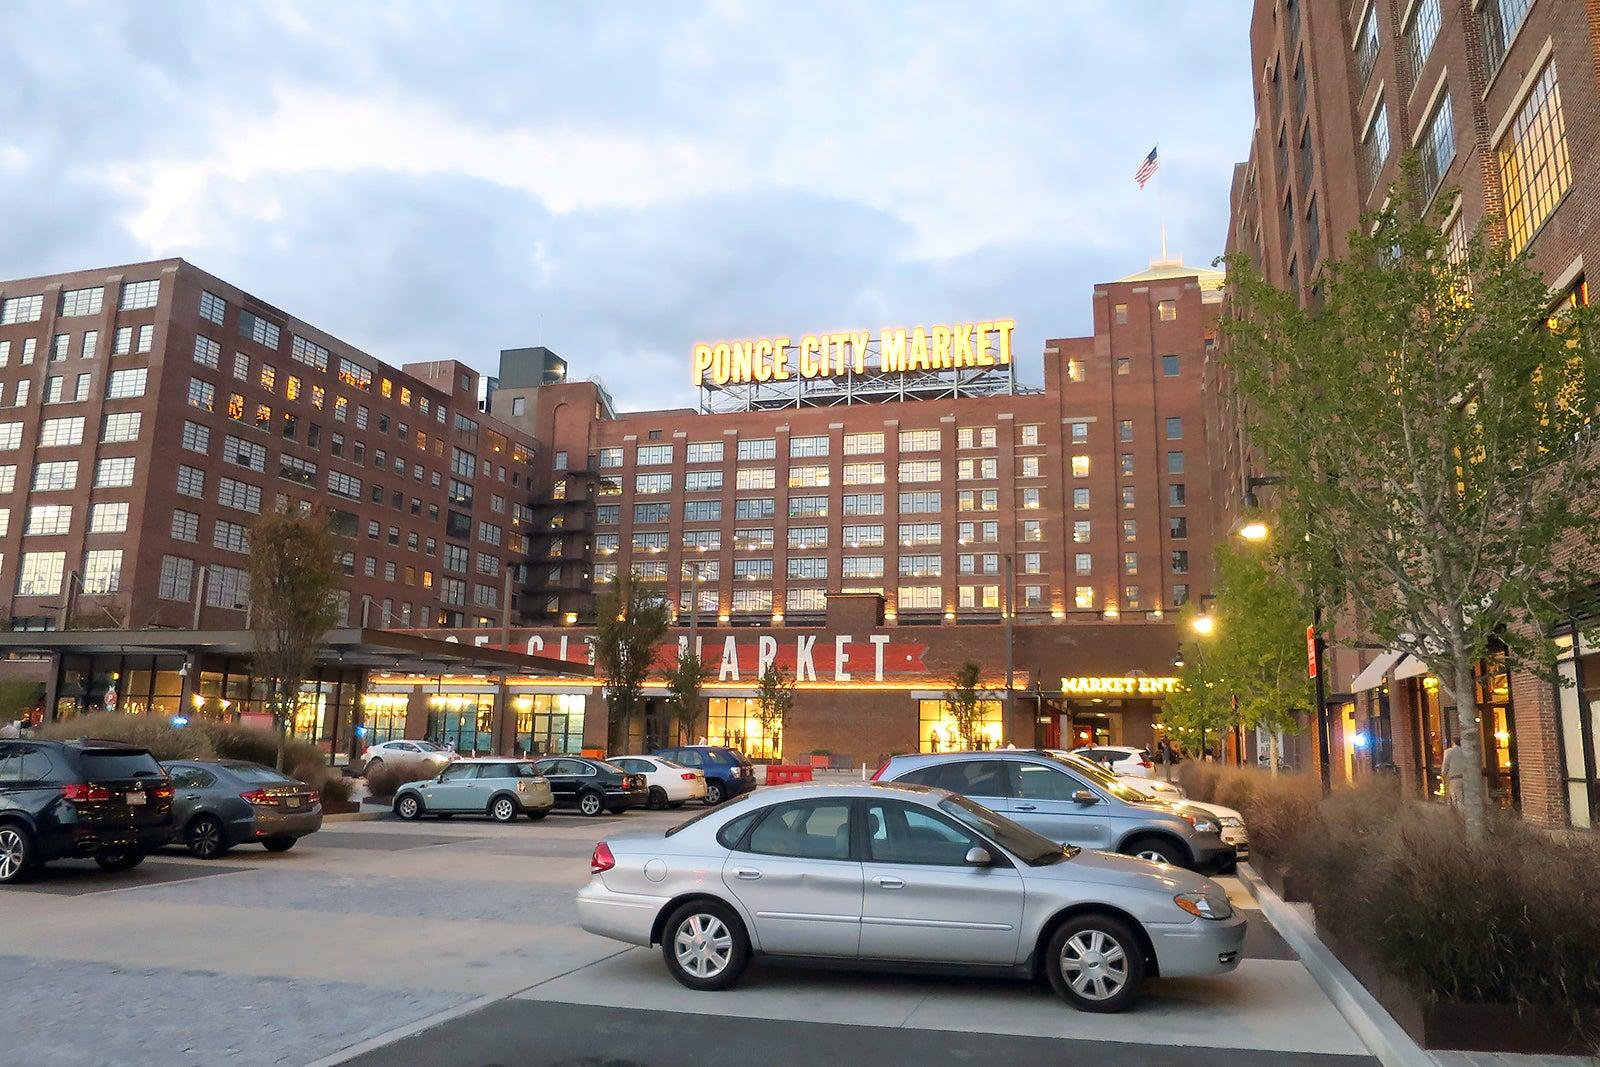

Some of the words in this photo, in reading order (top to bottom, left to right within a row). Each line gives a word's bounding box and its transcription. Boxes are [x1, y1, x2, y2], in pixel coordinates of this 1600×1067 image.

[693, 337, 791, 386] PONCE
[799, 330, 870, 379] CITY
[880, 319, 1014, 373] MARKET
[1060, 676, 1136, 693] MARKET
